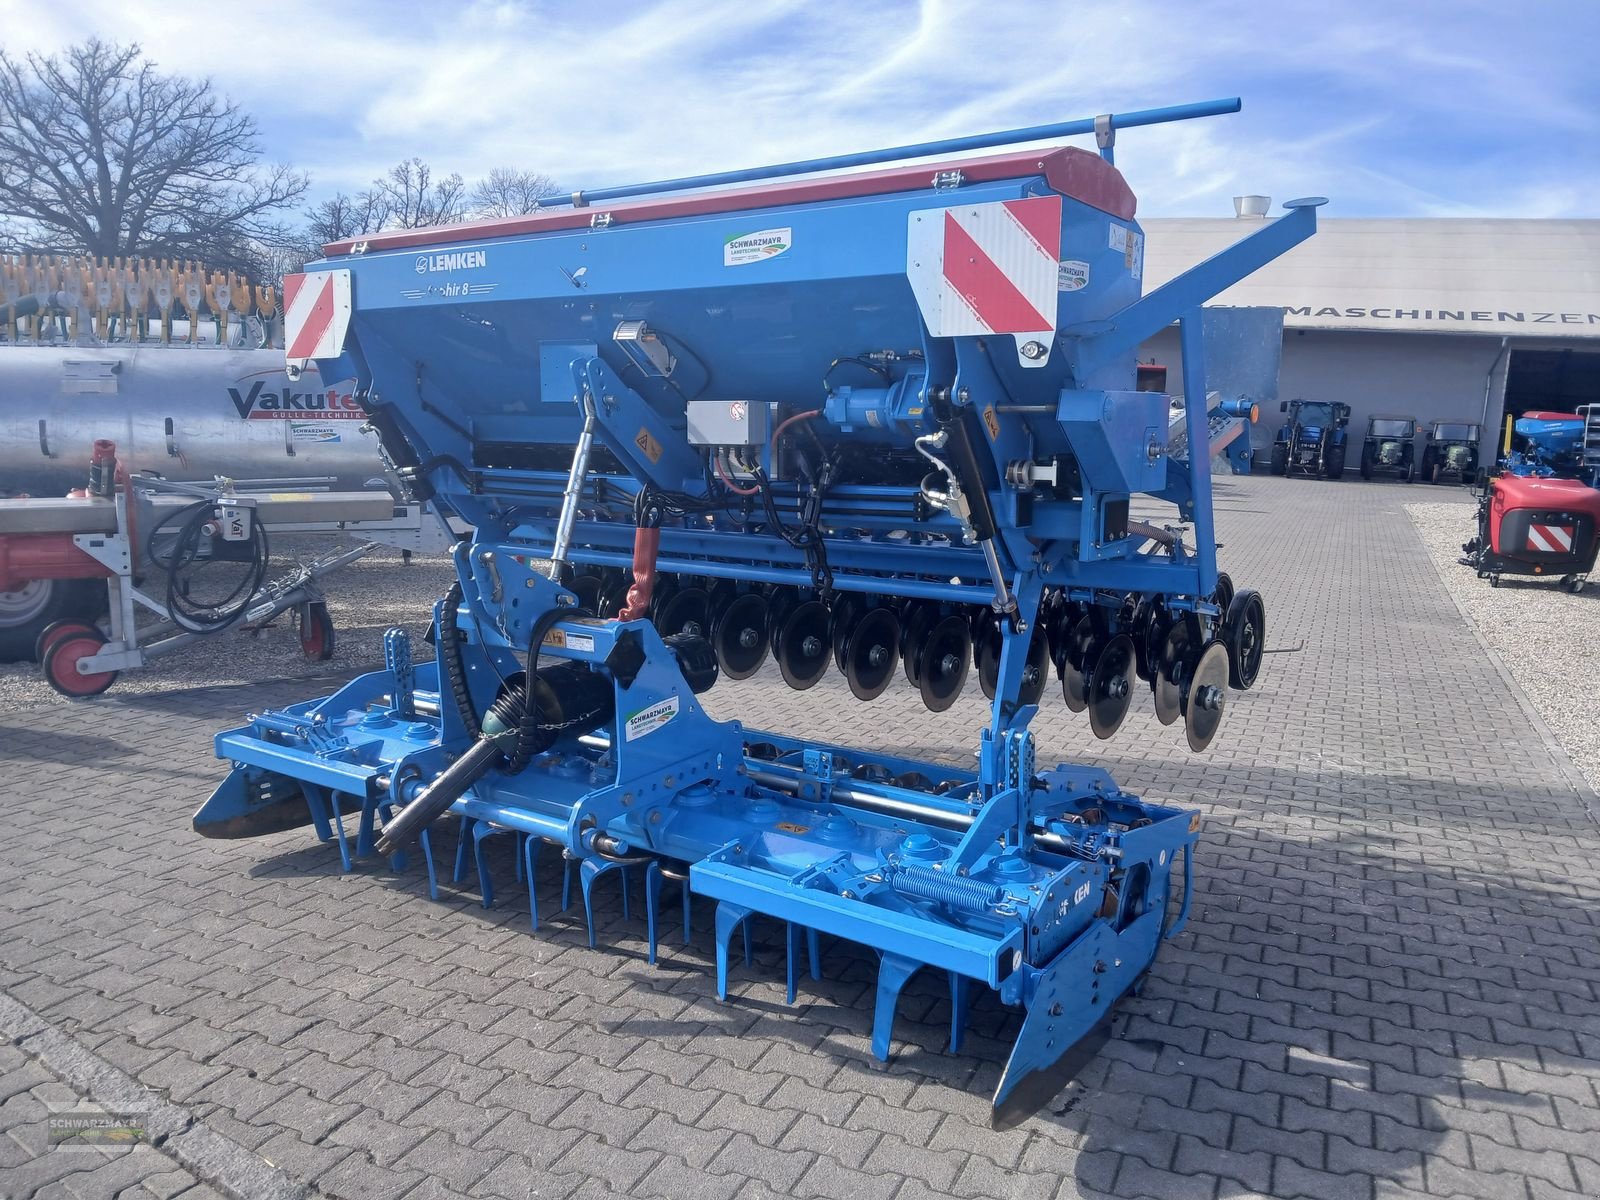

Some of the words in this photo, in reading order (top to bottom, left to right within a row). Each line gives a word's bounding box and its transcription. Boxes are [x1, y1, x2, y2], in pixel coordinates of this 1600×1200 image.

[729, 236, 782, 249] SCHWARZMAYR
[429, 251, 486, 274] LEMKEN
[461, 282, 470, 296] 8
[1209, 304, 1600, 325] MASCHINENZE
[227, 381, 363, 419] Vakute
[630, 705, 672, 725] SCHWARZMAYR
